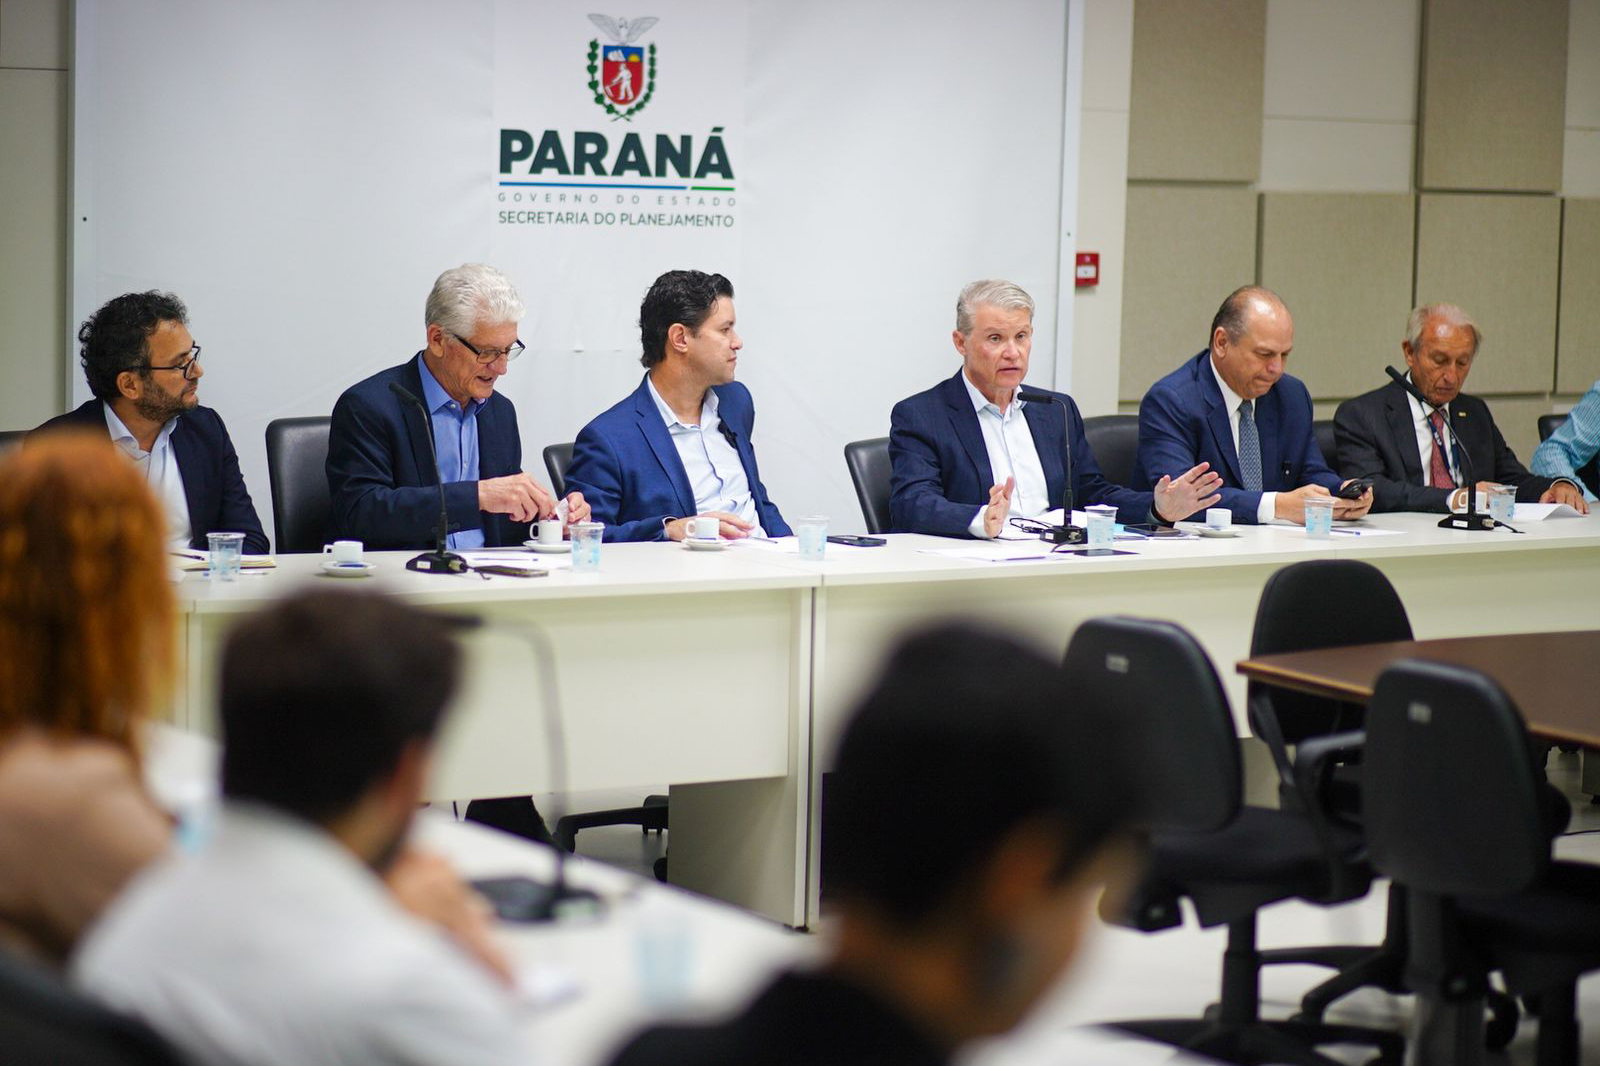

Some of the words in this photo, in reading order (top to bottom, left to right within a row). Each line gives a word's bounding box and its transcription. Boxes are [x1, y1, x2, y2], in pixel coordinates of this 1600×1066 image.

[499, 126, 735, 180] PARANÁ
[498, 192, 599, 204] GOVERNO
[616, 195, 640, 206] DO
[657, 196, 736, 208] ESTADO
[498, 210, 590, 225] SECRETARIA
[594, 211, 616, 226] DO
[620, 212, 735, 228] PLANEJAMENTO
